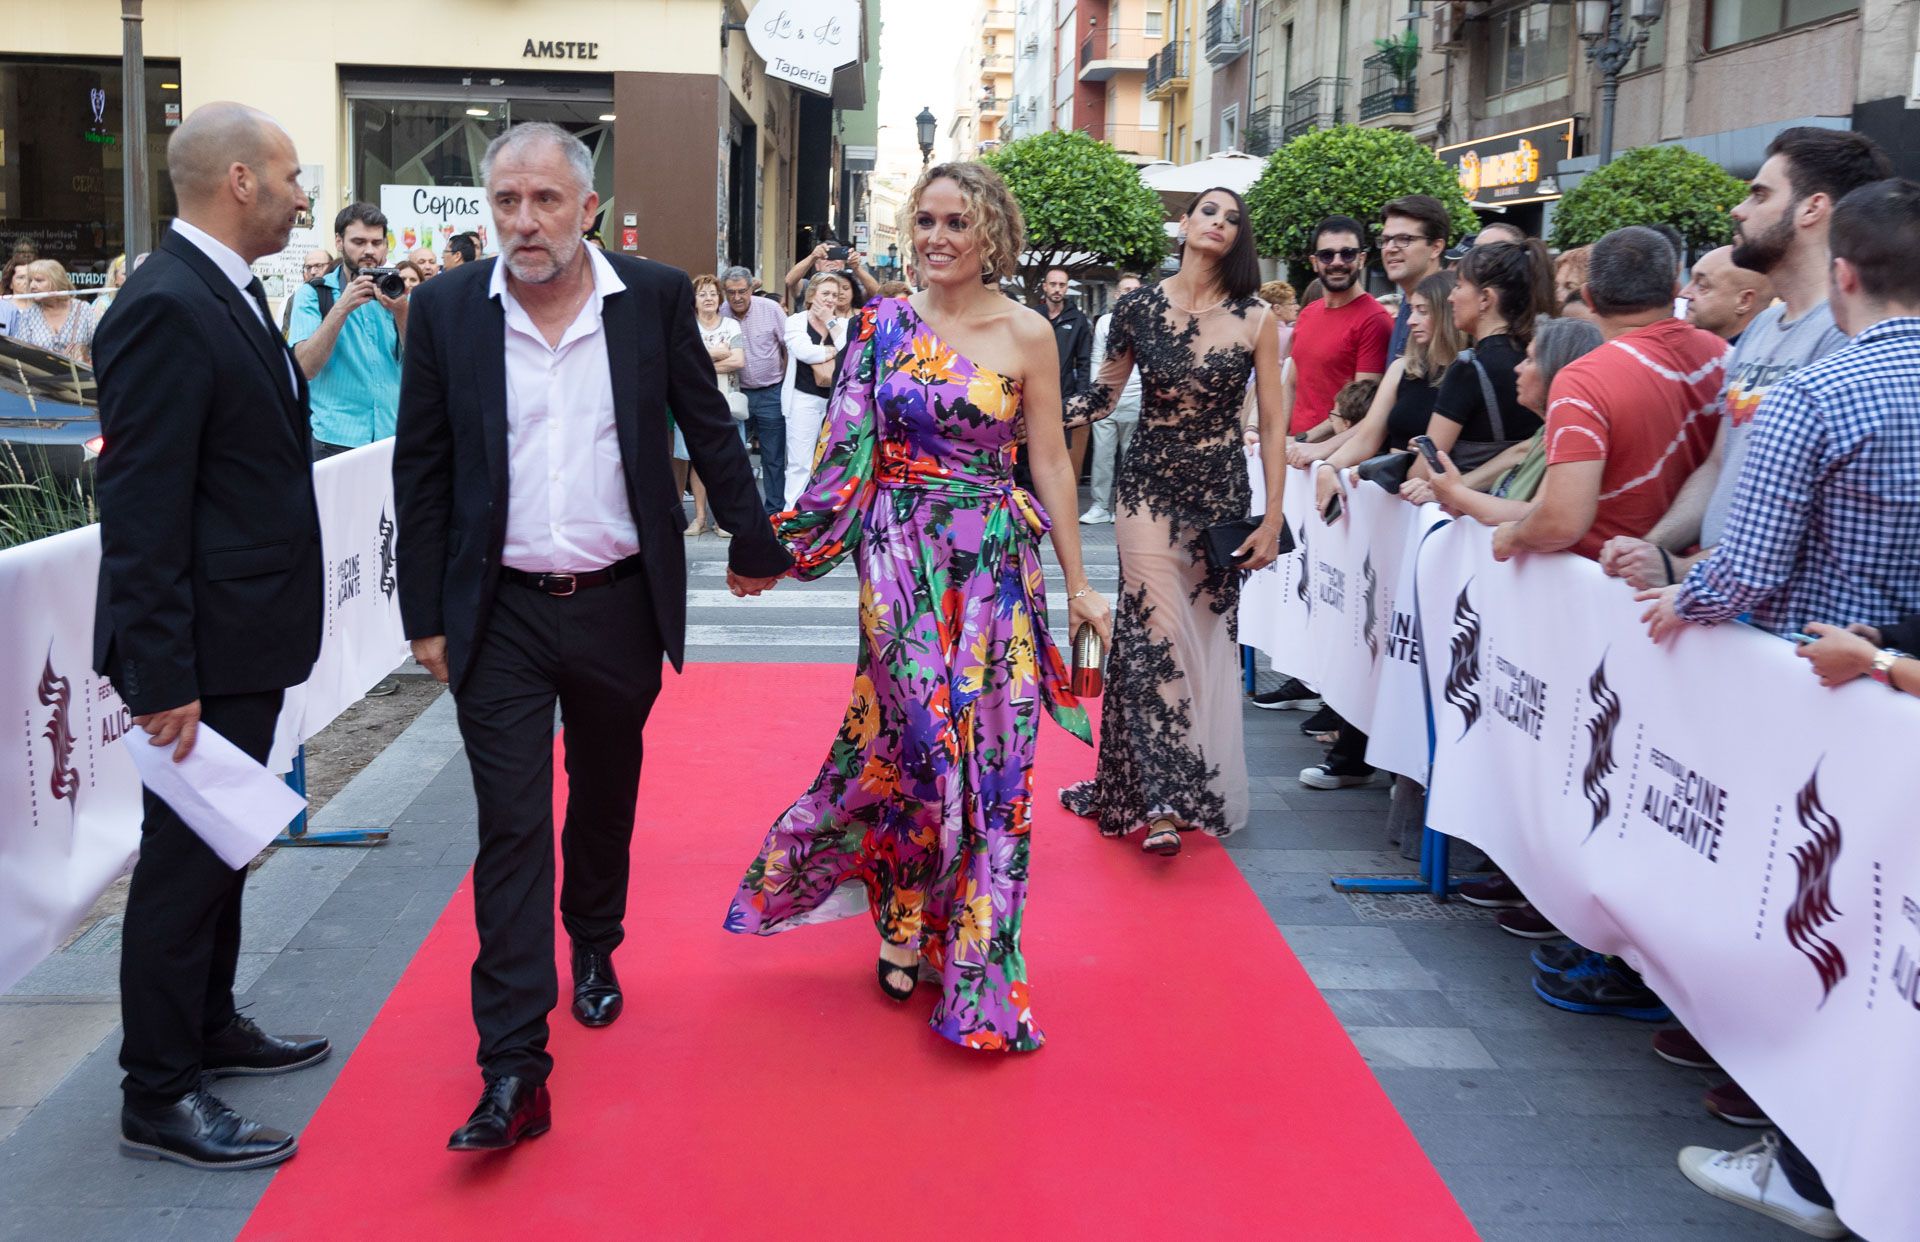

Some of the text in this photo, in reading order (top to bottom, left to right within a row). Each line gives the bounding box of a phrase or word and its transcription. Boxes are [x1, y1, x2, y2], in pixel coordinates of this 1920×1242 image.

[522, 38, 599, 60] AMSTEL
[797, 29, 805, 40] &
[413, 188, 480, 222] Copas
[1519, 670, 1547, 713] CINE
[102, 706, 134, 747] ALIC
[1493, 685, 1544, 741] ALICANTE
[1685, 770, 1728, 827] CINE
[1641, 784, 1722, 864] ALICANTE
